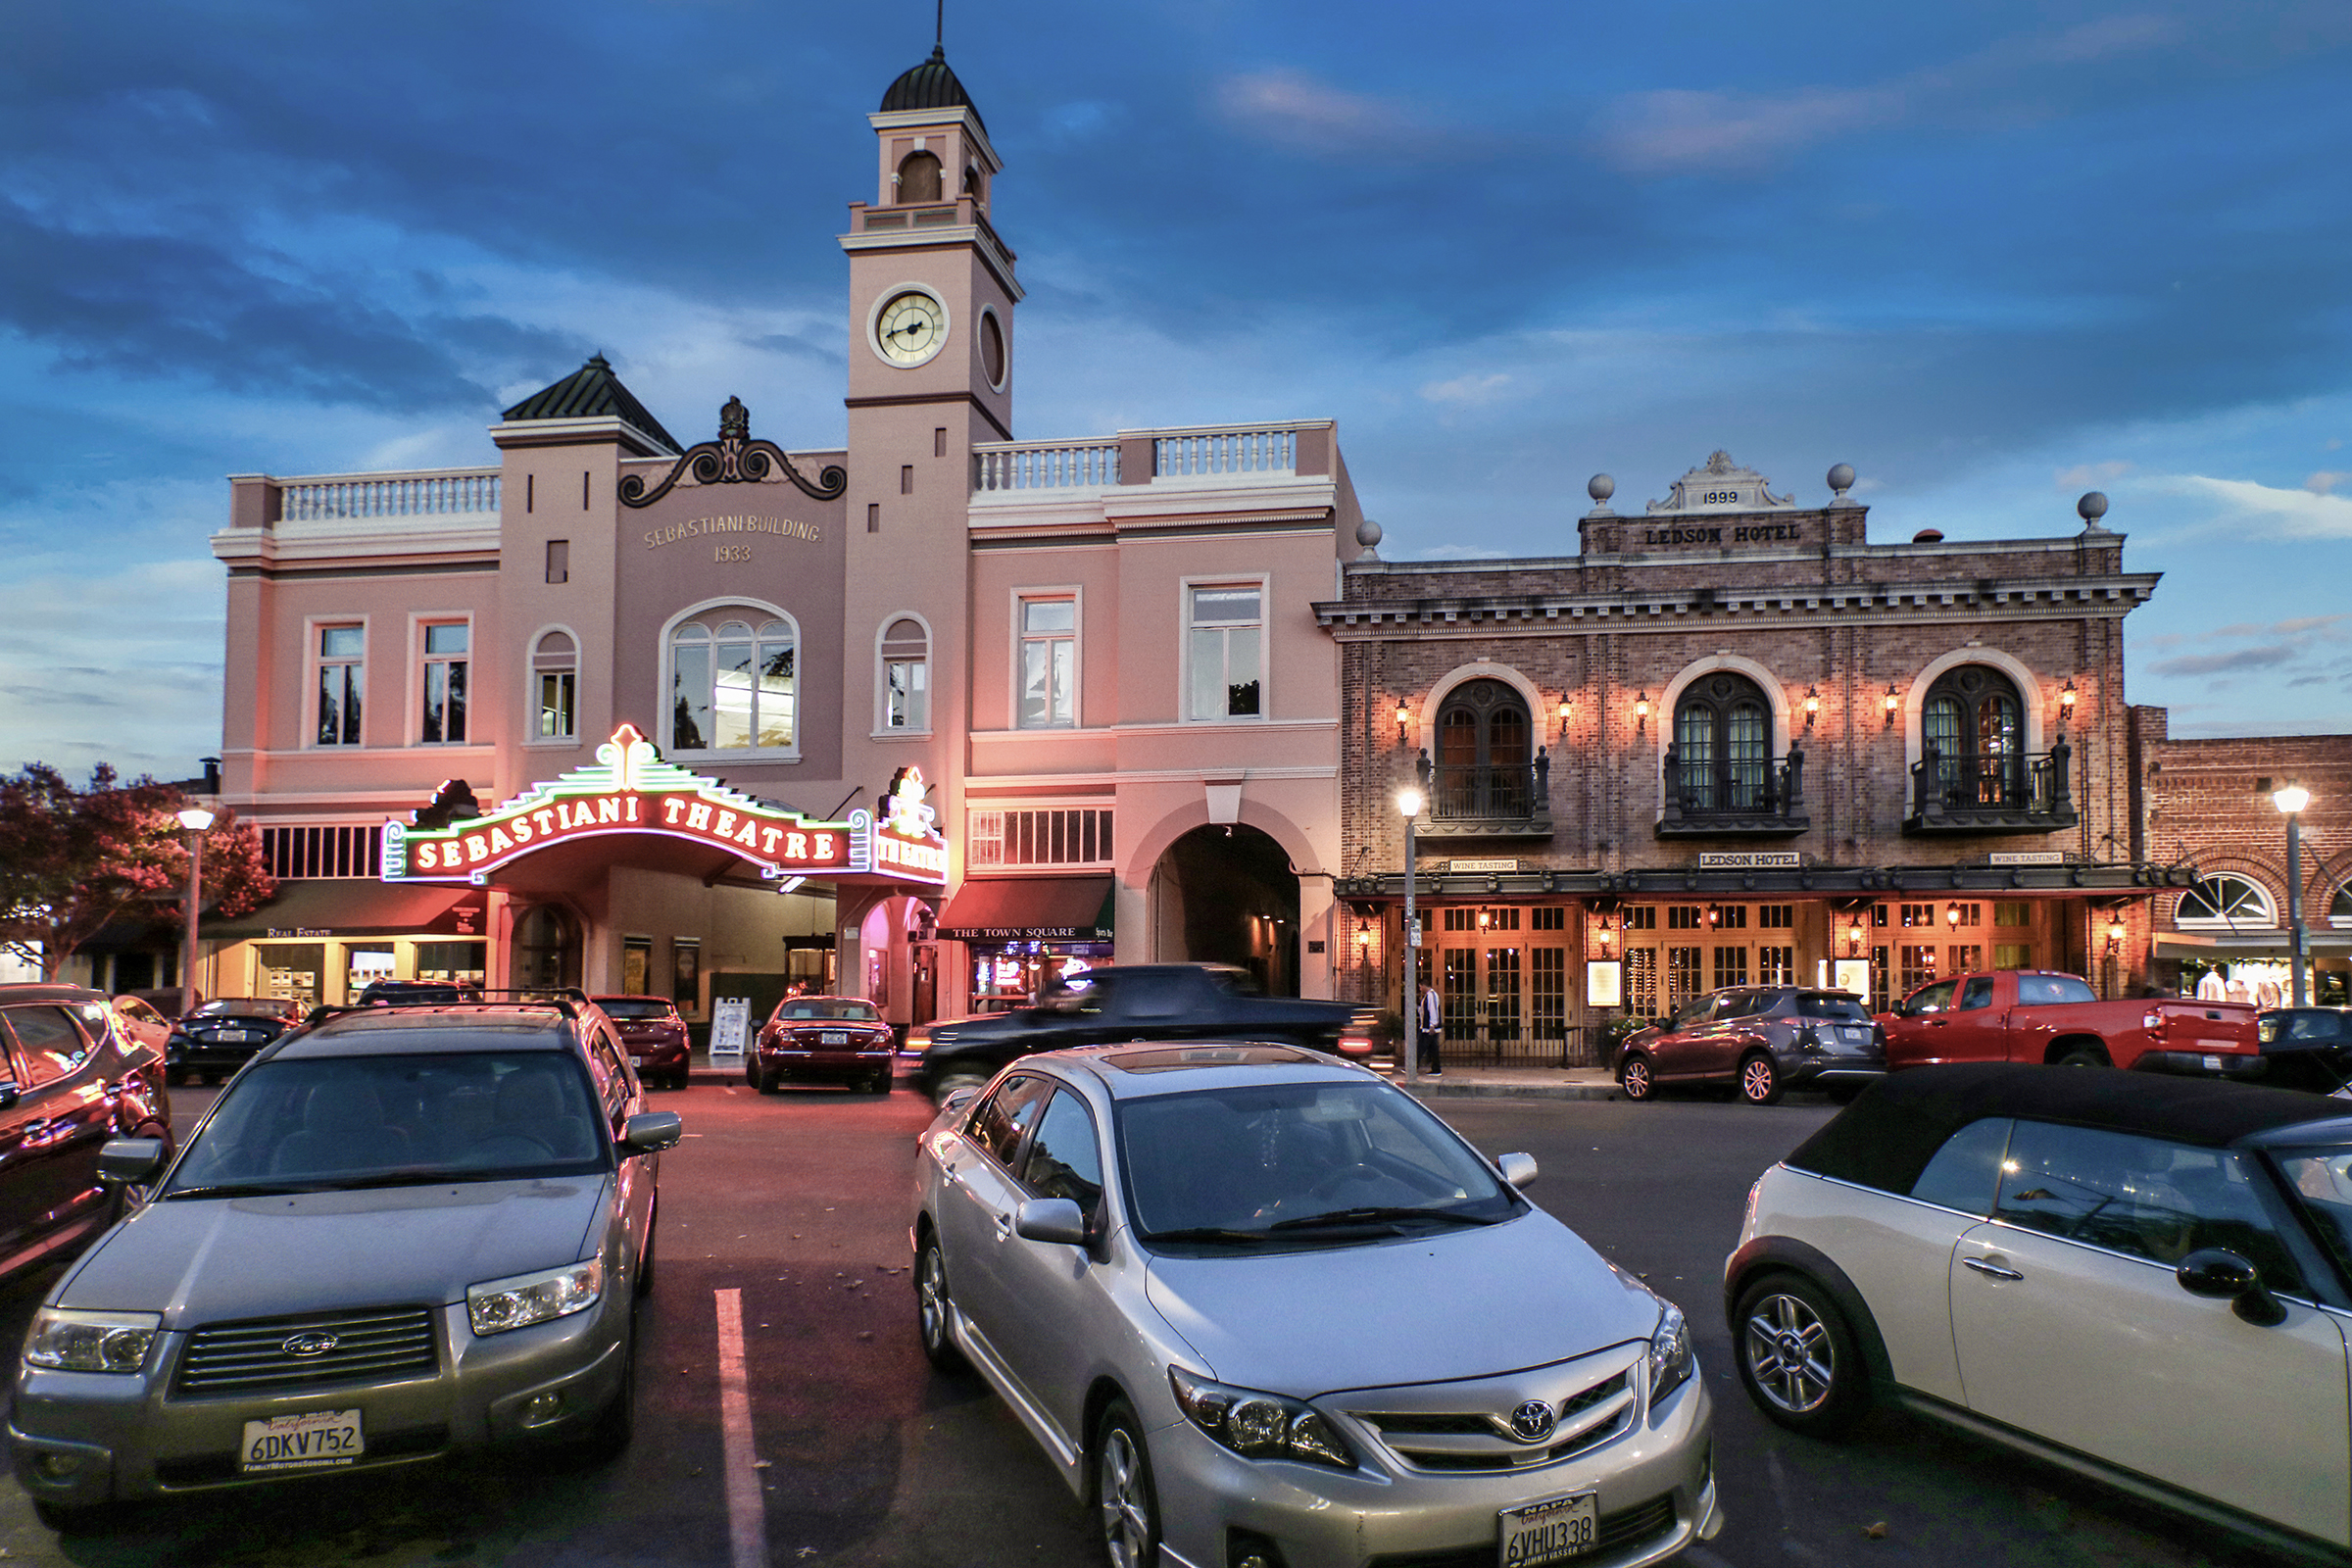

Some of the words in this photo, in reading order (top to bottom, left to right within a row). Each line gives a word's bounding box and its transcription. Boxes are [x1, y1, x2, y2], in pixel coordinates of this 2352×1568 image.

[1703, 491, 1738, 505] 1999
[644, 515, 744, 550] SEBASTIANI
[1645, 527, 1722, 545] LEDSON
[1734, 524, 1801, 542] HOTEL
[714, 545, 752, 563] 1933
[417, 797, 639, 868] SEBASTIANI
[664, 798, 834, 860] THEATRE
[1701, 855, 1752, 866] LEDSON
[1755, 854, 1798, 865] HOTEL
[2020, 854, 2060, 862] TASTING
[953, 928, 978, 938] THE
[983, 928, 1021, 937] TOWN
[1026, 927, 1076, 938] SQUARE
[269, 1414, 343, 1431] California
[251, 1426, 357, 1460] 6DKV752
[1521, 1504, 1580, 1525] California
[1524, 1498, 1574, 1515] NAPA
[1508, 1516, 1592, 1558] 6VHU338
[1522, 1553, 1548, 1567] JIMMY
[1548, 1545, 1578, 1560] VASSER
